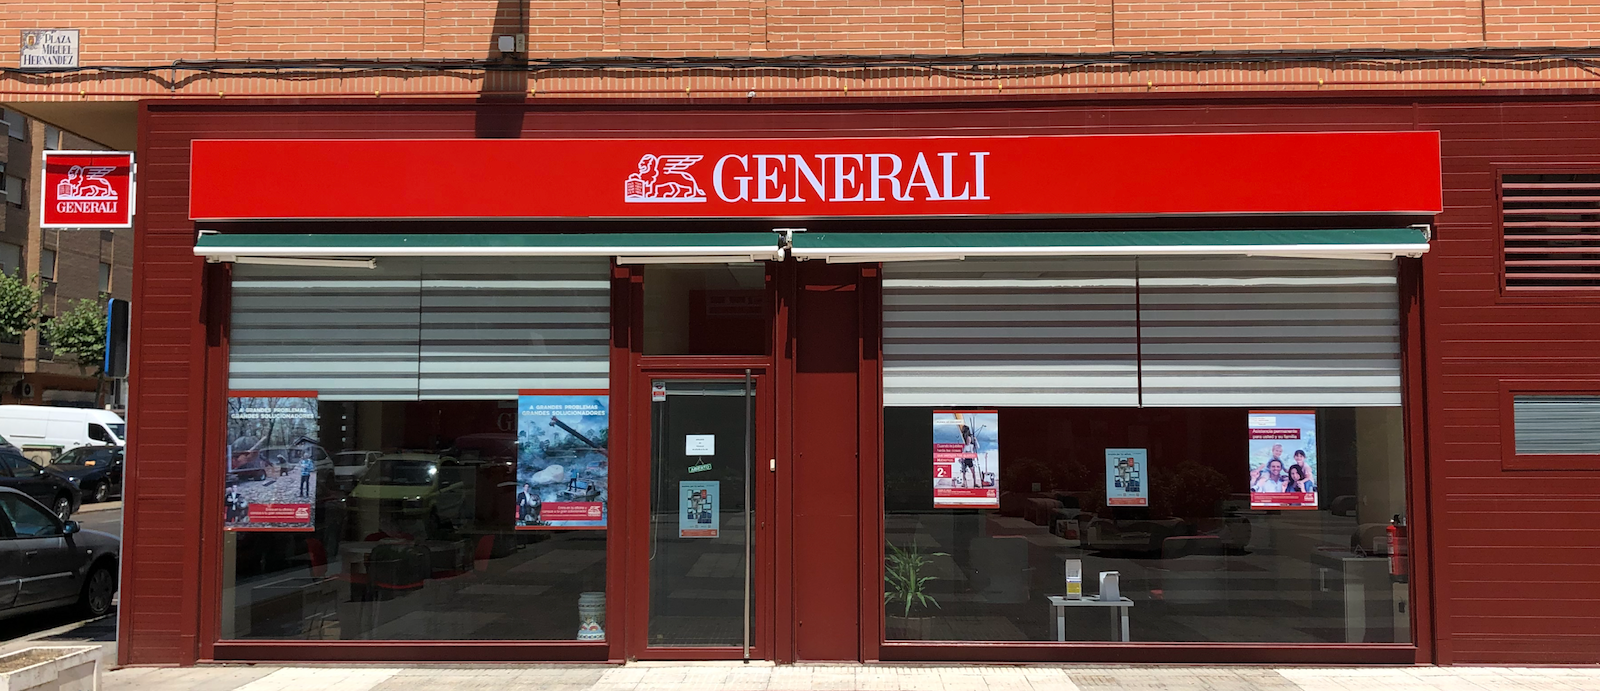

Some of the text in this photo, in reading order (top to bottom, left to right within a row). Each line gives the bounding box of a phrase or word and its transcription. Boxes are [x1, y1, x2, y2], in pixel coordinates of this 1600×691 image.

[45, 34, 71, 43] PLAZA
[42, 44, 73, 54] MIGUEL
[24, 54, 73, 65] HERNANDEZ
[712, 151, 991, 203] GENERALI
[56, 201, 118, 213] GENERALI
